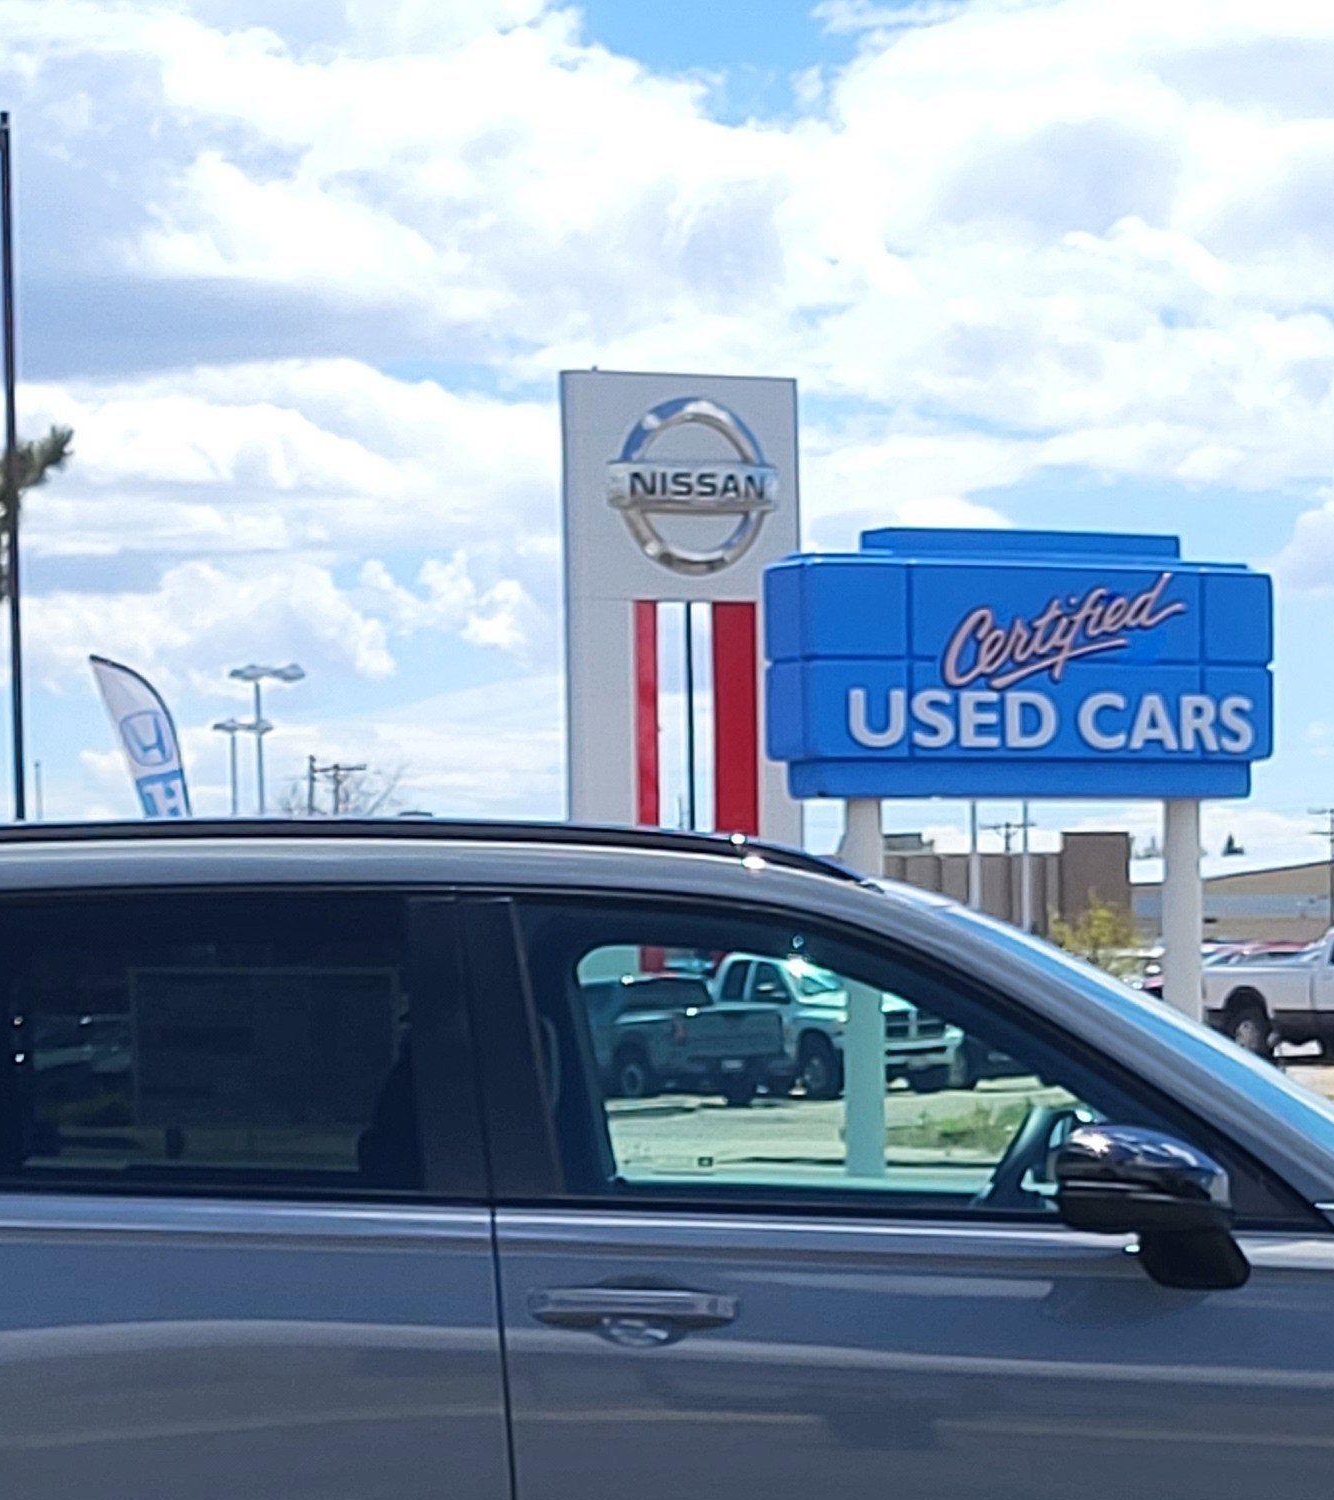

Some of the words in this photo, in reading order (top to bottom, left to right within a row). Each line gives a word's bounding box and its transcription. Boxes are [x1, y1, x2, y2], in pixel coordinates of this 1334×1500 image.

[629, 470, 765, 500] NISSAN
[943, 571, 1186, 687] Certified
[848, 688, 1057, 749] USED
[1077, 692, 1255, 753] CARS
